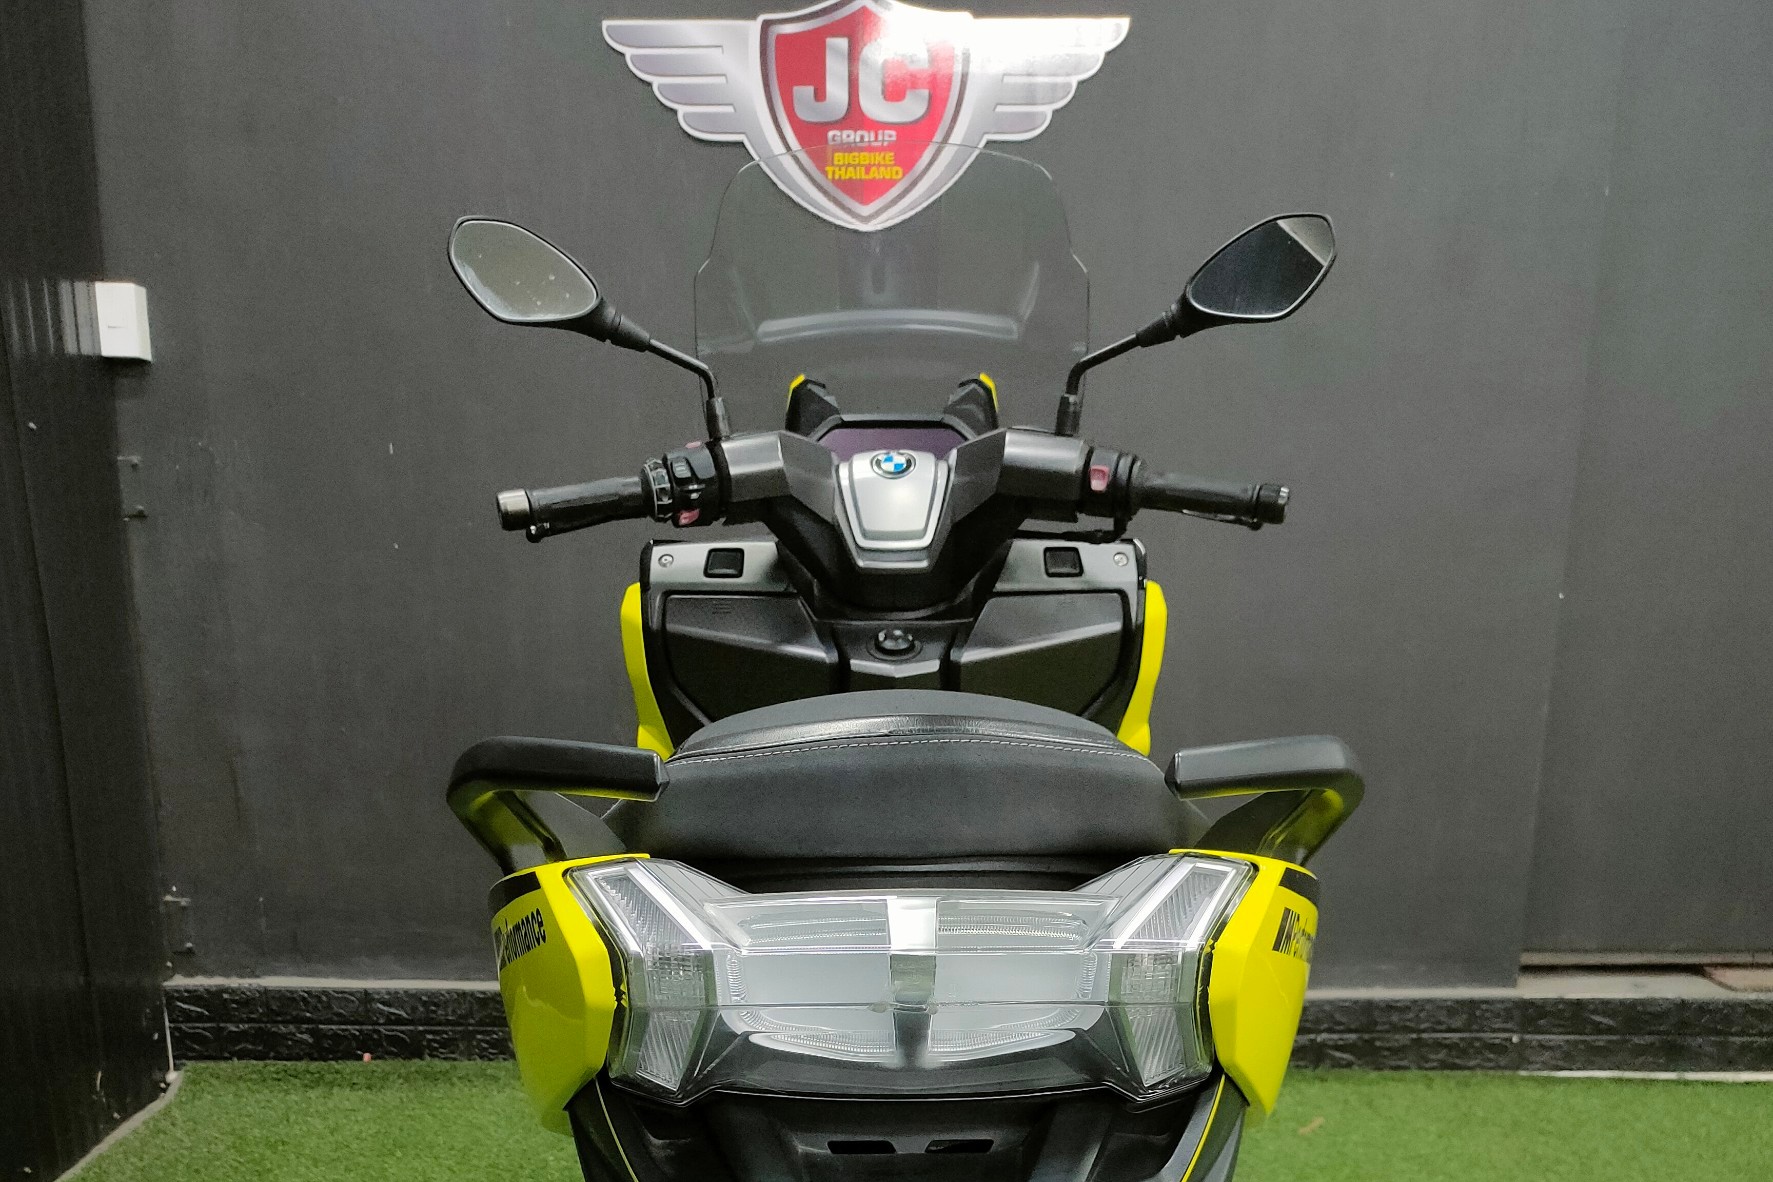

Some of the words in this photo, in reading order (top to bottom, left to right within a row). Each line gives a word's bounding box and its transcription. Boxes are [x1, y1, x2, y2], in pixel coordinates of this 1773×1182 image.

[793, 37, 930, 124] JC
[827, 130, 897, 147] GROUP
[833, 152, 896, 166] BIGBIKE
[825, 166, 903, 181] THAILAND
